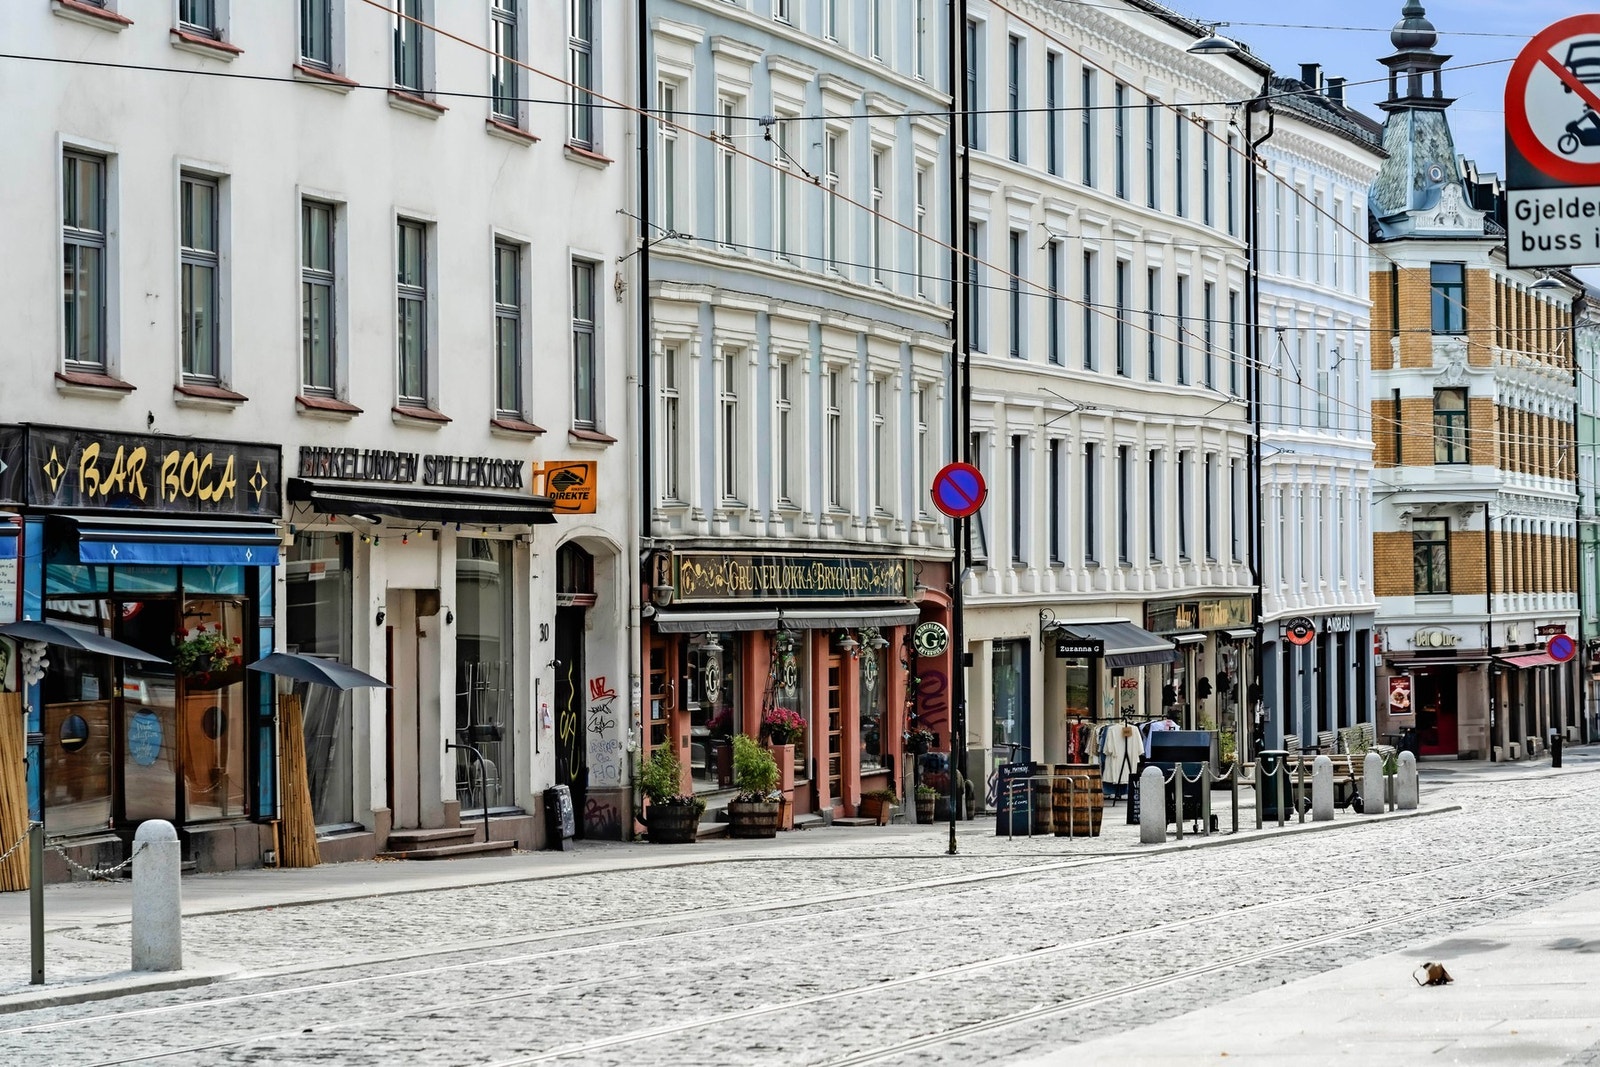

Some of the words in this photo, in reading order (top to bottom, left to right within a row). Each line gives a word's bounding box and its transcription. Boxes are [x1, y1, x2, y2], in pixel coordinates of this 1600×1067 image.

[1515, 196, 1600, 226] Gjelde
[1522, 230, 1582, 252] buss
[1595, 227, 1600, 249] i
[79, 442, 148, 500] BAR
[161, 450, 237, 502] BOCA
[298, 446, 420, 482] BIRKELUNDEN
[422, 454, 525, 489] SPILLEKIOSK
[550, 491, 590, 500] DIREKTE
[817, 562, 869, 591] BRYGGHUS
[539, 622, 549, 642] 30
[921, 631, 939, 648] G
